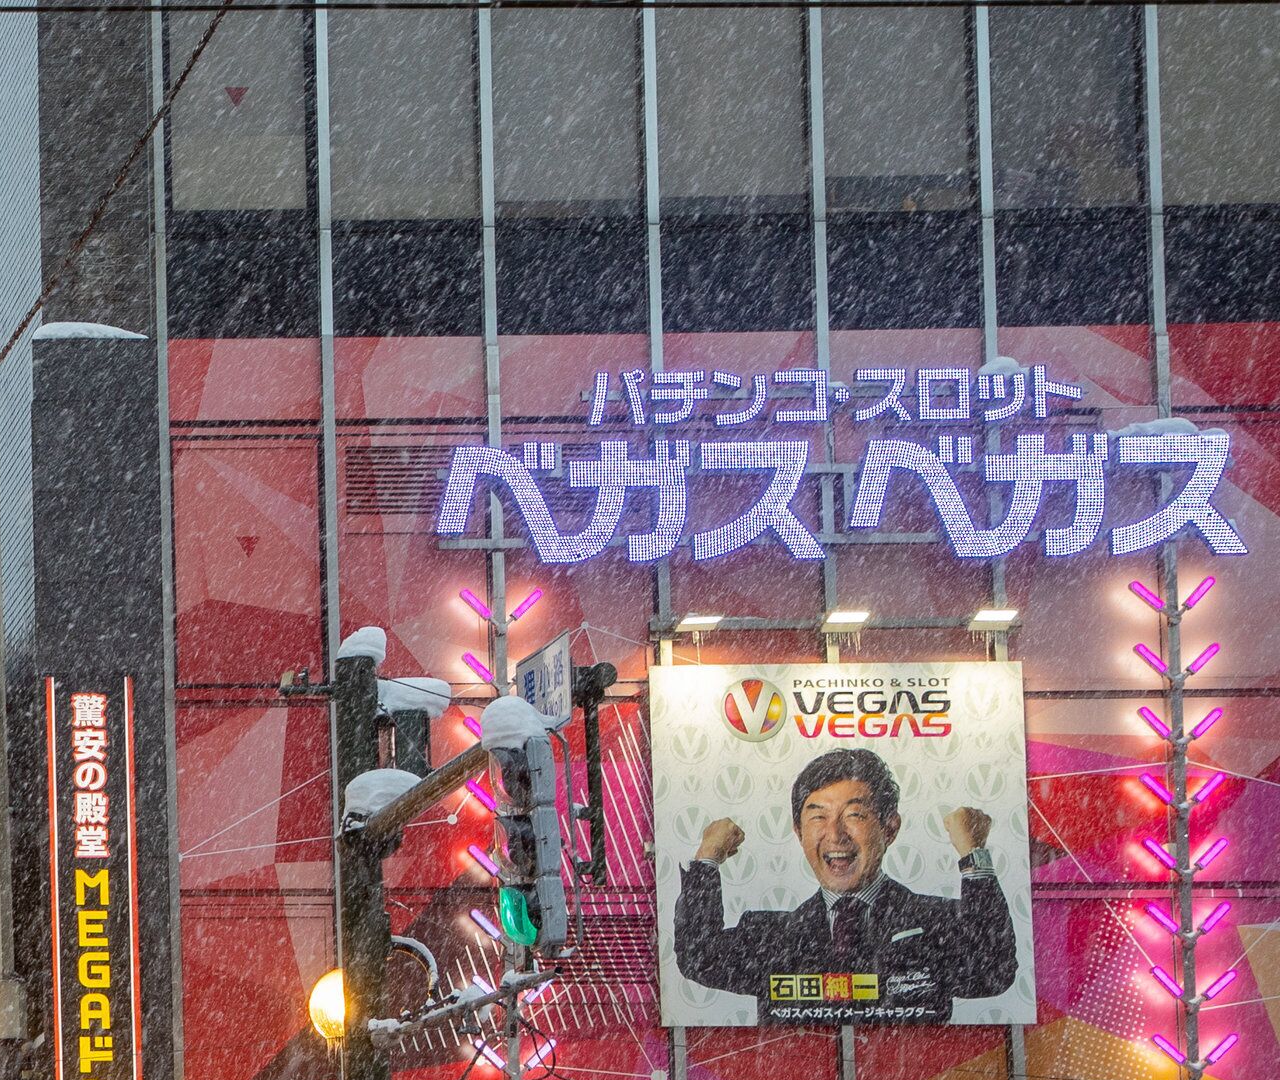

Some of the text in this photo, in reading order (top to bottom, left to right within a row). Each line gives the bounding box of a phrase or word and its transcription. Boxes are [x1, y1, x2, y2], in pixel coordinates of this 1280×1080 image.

[588, 363, 1082, 426] パチンコ・スロット
[792, 677, 951, 689] PACHINKO & SLOT
[792, 690, 951, 715] VEGAS
[792, 713, 952, 738] VEGAS
[71, 695, 111, 859] 驚安の殿堂
[771, 974, 878, 999] 石田純一
[770, 1006, 936, 1018] ベガスベガスイメージキャラクター
